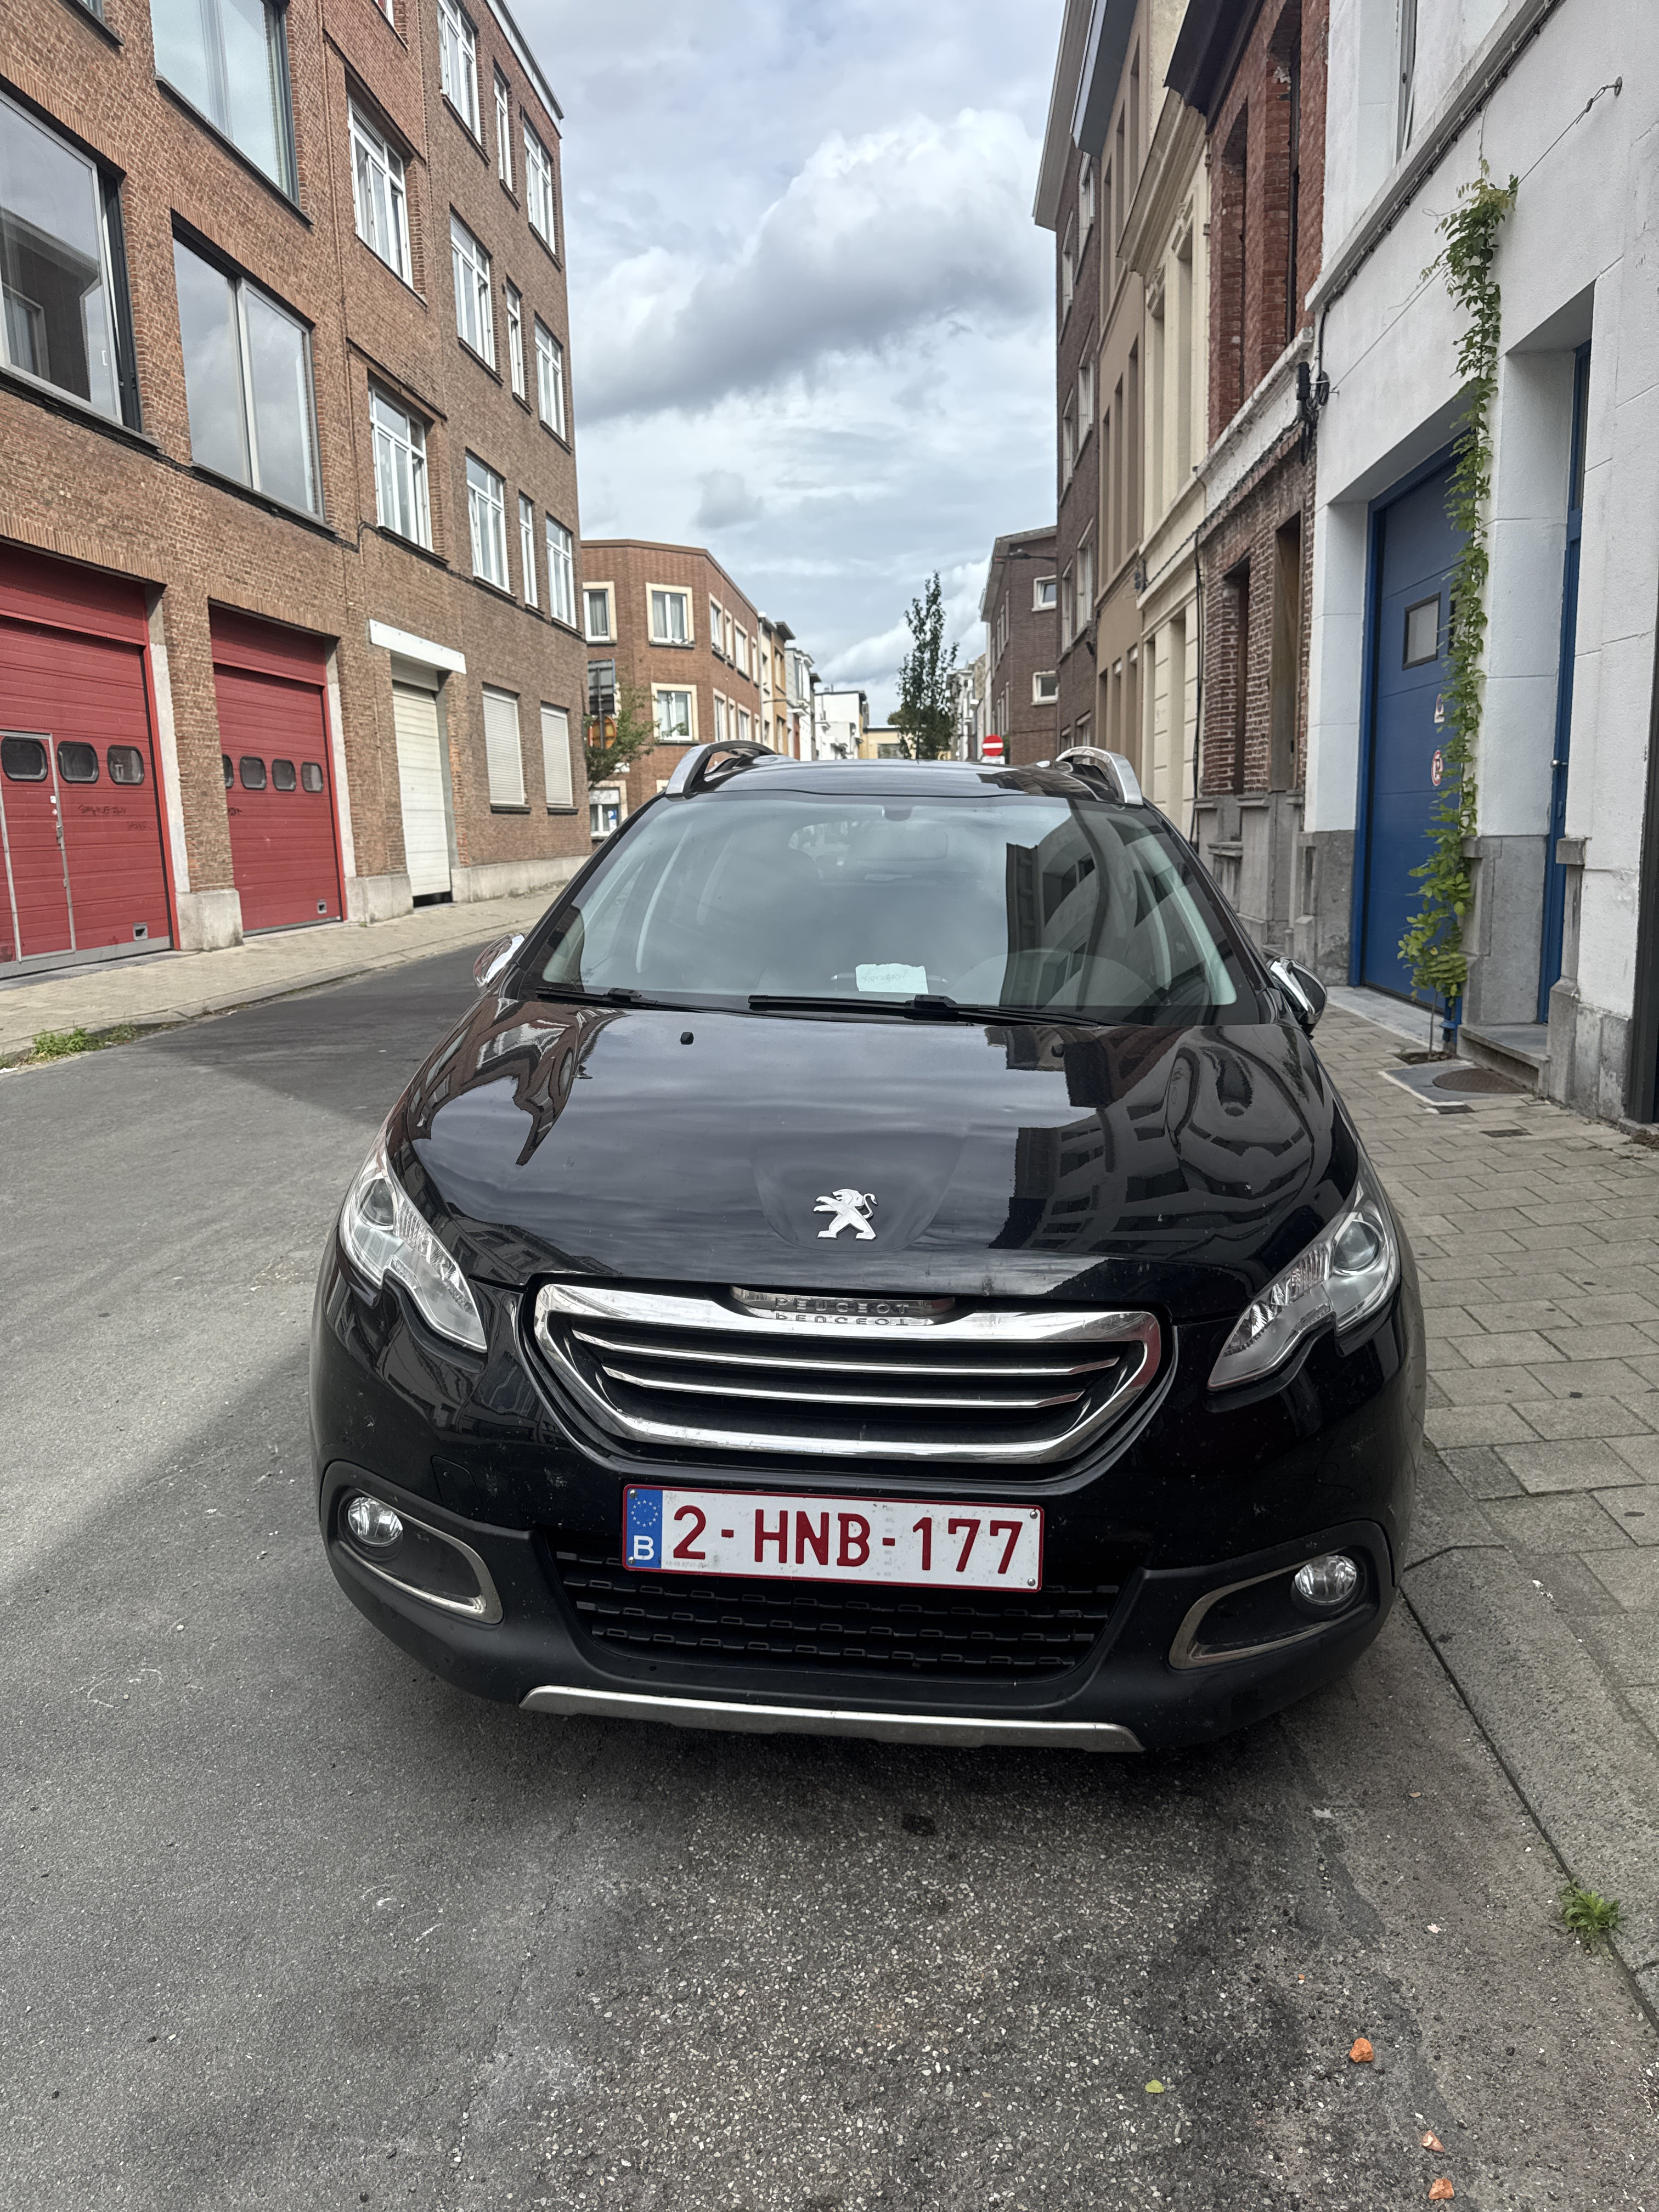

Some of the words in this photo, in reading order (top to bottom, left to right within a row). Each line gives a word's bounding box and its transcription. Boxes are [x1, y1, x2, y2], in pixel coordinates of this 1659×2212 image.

[608, 810, 614, 819] P
[775, 1297, 909, 1314] PEUGEOT
[633, 1535, 654, 1560] B
[673, 1505, 1023, 1575] 2-HNB-177
